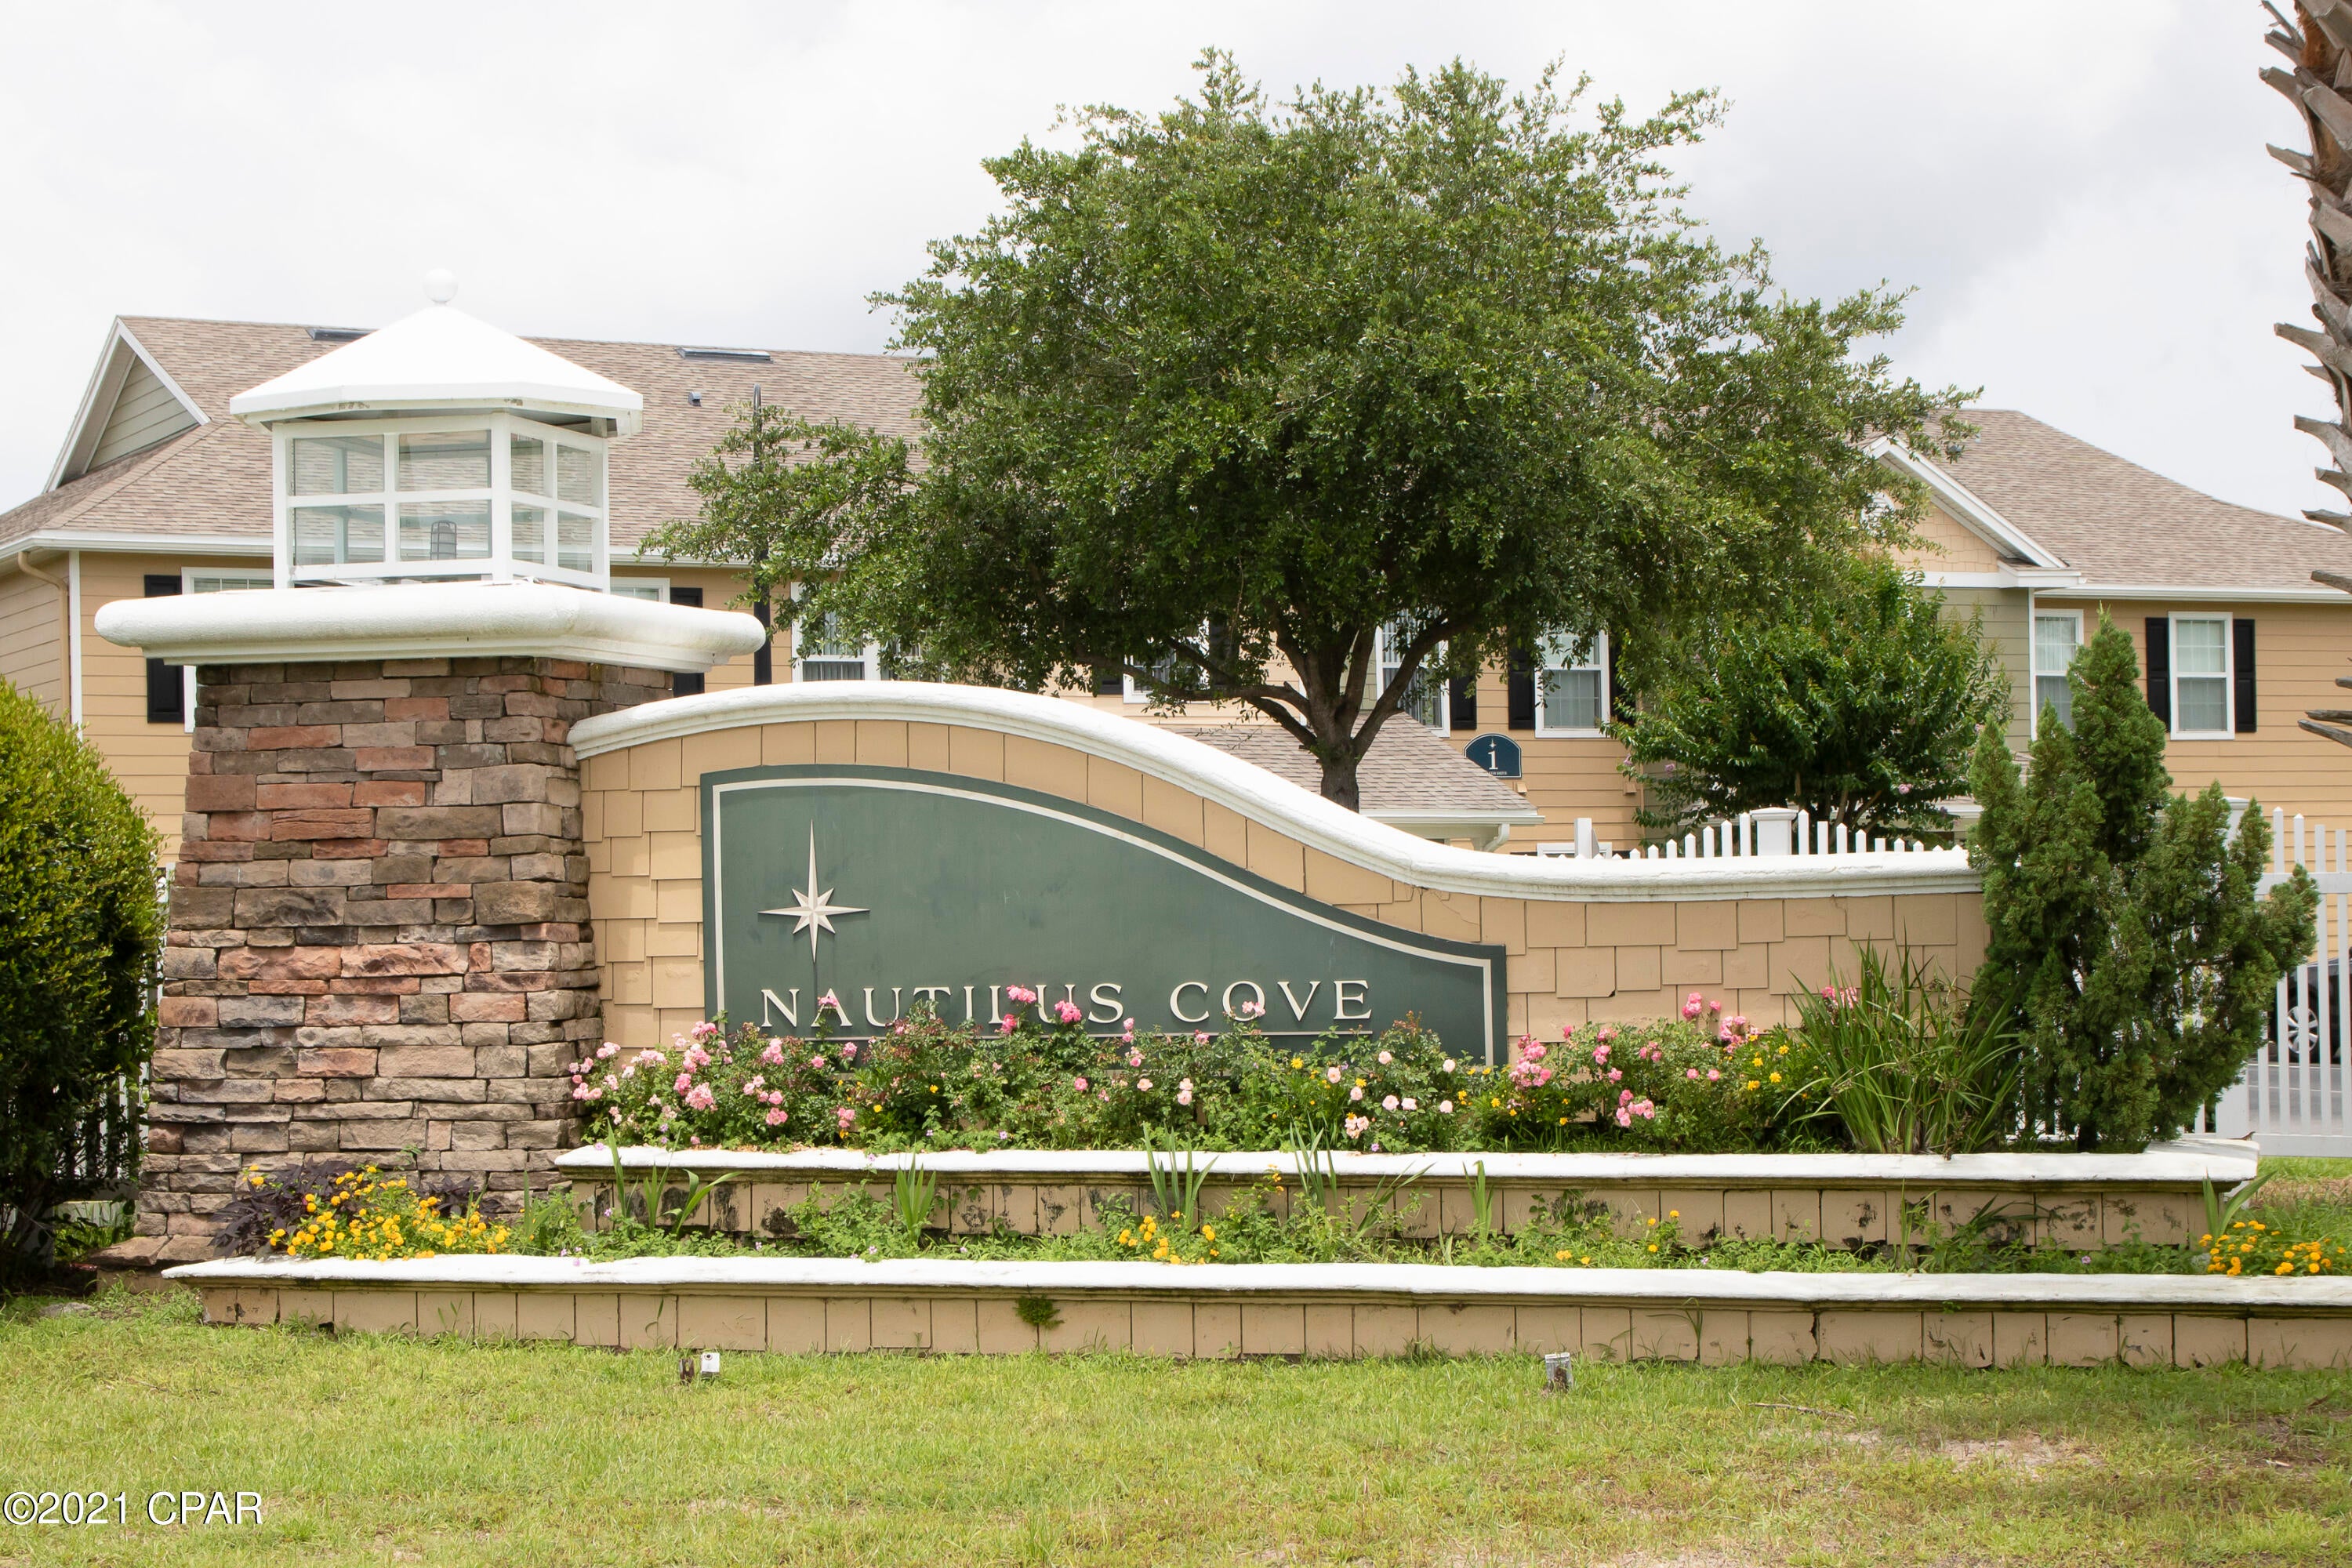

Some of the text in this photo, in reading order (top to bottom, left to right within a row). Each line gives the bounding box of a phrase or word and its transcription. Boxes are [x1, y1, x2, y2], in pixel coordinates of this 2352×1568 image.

[1488, 750, 1498, 769] 1
[760, 979, 1373, 1028] NAUTILUS COVE
